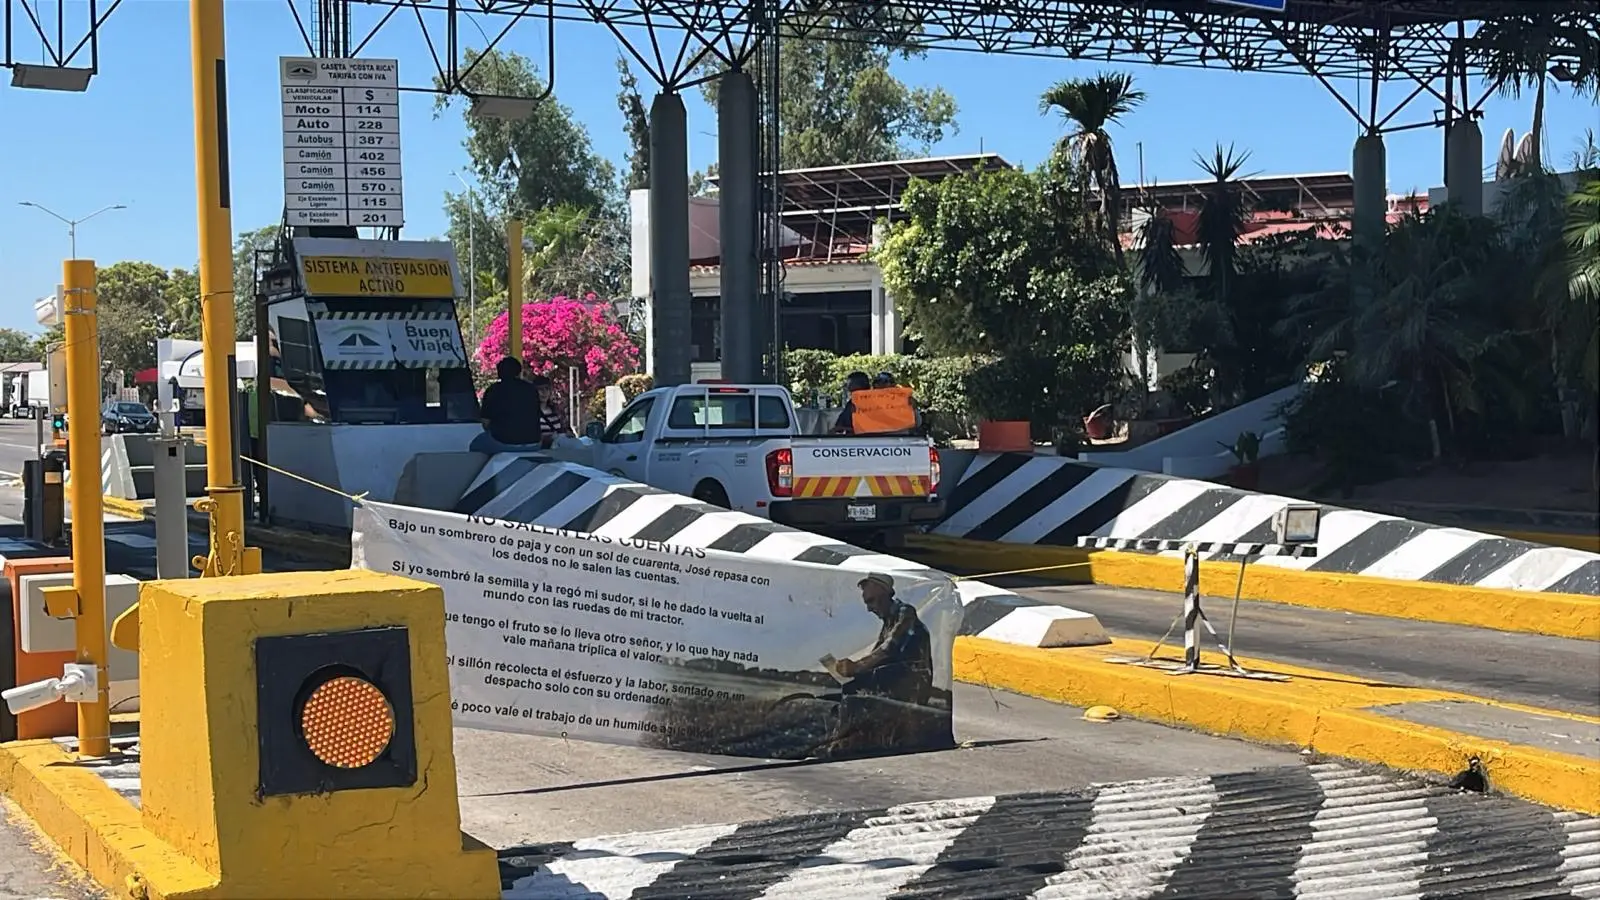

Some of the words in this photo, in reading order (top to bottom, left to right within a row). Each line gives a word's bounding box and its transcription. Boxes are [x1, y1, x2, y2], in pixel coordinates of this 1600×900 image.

[296, 106, 330, 114] Moto
[356, 106, 381, 114] 114
[297, 118, 330, 128] Auto
[358, 121, 383, 130] 228
[359, 136, 384, 144] 387
[360, 152, 384, 160] 402
[360, 167, 386, 176] 456
[362, 183, 386, 192] 570
[362, 198, 387, 206] 115
[362, 214, 387, 222] 201
[304, 260, 359, 274] SISTEMA
[365, 262, 449, 276] ANTIEVASION
[360, 280, 404, 292] ACTIVO
[406, 326, 450, 340] Buen
[408, 339, 453, 354] Viaje
[812, 446, 912, 458] CONSERVACIÓN
[389, 519, 416, 533] Bajo
[421, 525, 435, 534] un
[438, 528, 496, 544] sombrero
[500, 536, 513, 546] de
[518, 540, 541, 552] paja
[544, 544, 551, 553] y
[554, 545, 575, 555] con
[580, 549, 592, 558] un
[596, 551, 613, 560] sol
[616, 553, 630, 564] de
[632, 559, 682, 573] cuarenta,
[685, 564, 710, 576] José
[714, 569, 748, 583] repasa
[750, 576, 770, 586] con
[492, 548, 509, 560] los
[514, 550, 548, 564] dedos
[552, 558, 566, 568] no
[570, 560, 579, 570] le
[582, 562, 612, 574] salen
[616, 566, 631, 578] las
[634, 571, 680, 585] cuentas.
[392, 560, 405, 572] Si
[408, 564, 423, 575] yo
[426, 567, 470, 582] sembré
[474, 572, 484, 582] la
[488, 576, 529, 589] semilla
[532, 582, 540, 592] y
[542, 582, 552, 592] la
[556, 586, 580, 598] regó
[584, 590, 598, 600] mi
[601, 592, 635, 606] sudor,
[638, 597, 648, 606] si
[652, 598, 660, 608] le
[664, 600, 678, 611] he
[680, 602, 706, 616] dado
[709, 606, 718, 618] la
[720, 610, 752, 622] vuelta
[754, 616, 764, 624] al
[483, 590, 525, 603] mundo
[528, 595, 550, 606] con
[552, 597, 569, 608] las
[572, 602, 610, 614] ruedas
[614, 606, 627, 617] de
[630, 610, 644, 620] mi
[646, 612, 684, 626] tractor.
[445, 612, 459, 622] ue
[462, 614, 495, 628] tengo
[498, 619, 508, 629] el
[512, 620, 540, 632] fruto
[544, 625, 557, 636] se
[560, 626, 570, 636] lo
[574, 628, 600, 640] lleva
[604, 632, 626, 644] otro
[629, 636, 662, 650] señor,
[666, 642, 672, 652] y
[676, 642, 686, 652] lo
[688, 646, 708, 656] que
[712, 647, 730, 660] hay
[734, 651, 759, 662] nada
[503, 634, 526, 646] vale
[530, 638, 575, 652] mañana
[620, 649, 630, 658] el
[633, 650, 662, 662] valor.
[458, 656, 491, 670] sillón
[495, 662, 548, 676] recolecta
[552, 668, 561, 678] el
[616, 678, 622, 688] y
[626, 677, 634, 688] la
[638, 679, 668, 692] labor,
[672, 684, 714, 697] sentado
[716, 690, 729, 700] en
[732, 692, 745, 701] un
[484, 674, 542, 690] despacho
[545, 682, 570, 694] solo
[572, 686, 593, 696] con
[596, 690, 610, 698] su
[452, 700, 458, 710] é
[462, 702, 491, 713] poco
[494, 706, 518, 716] vale
[522, 708, 532, 718] el
[536, 710, 575, 724] trabajo
[578, 714, 592, 725] de
[596, 718, 610, 727] un
[613, 718, 657, 732] humilde
